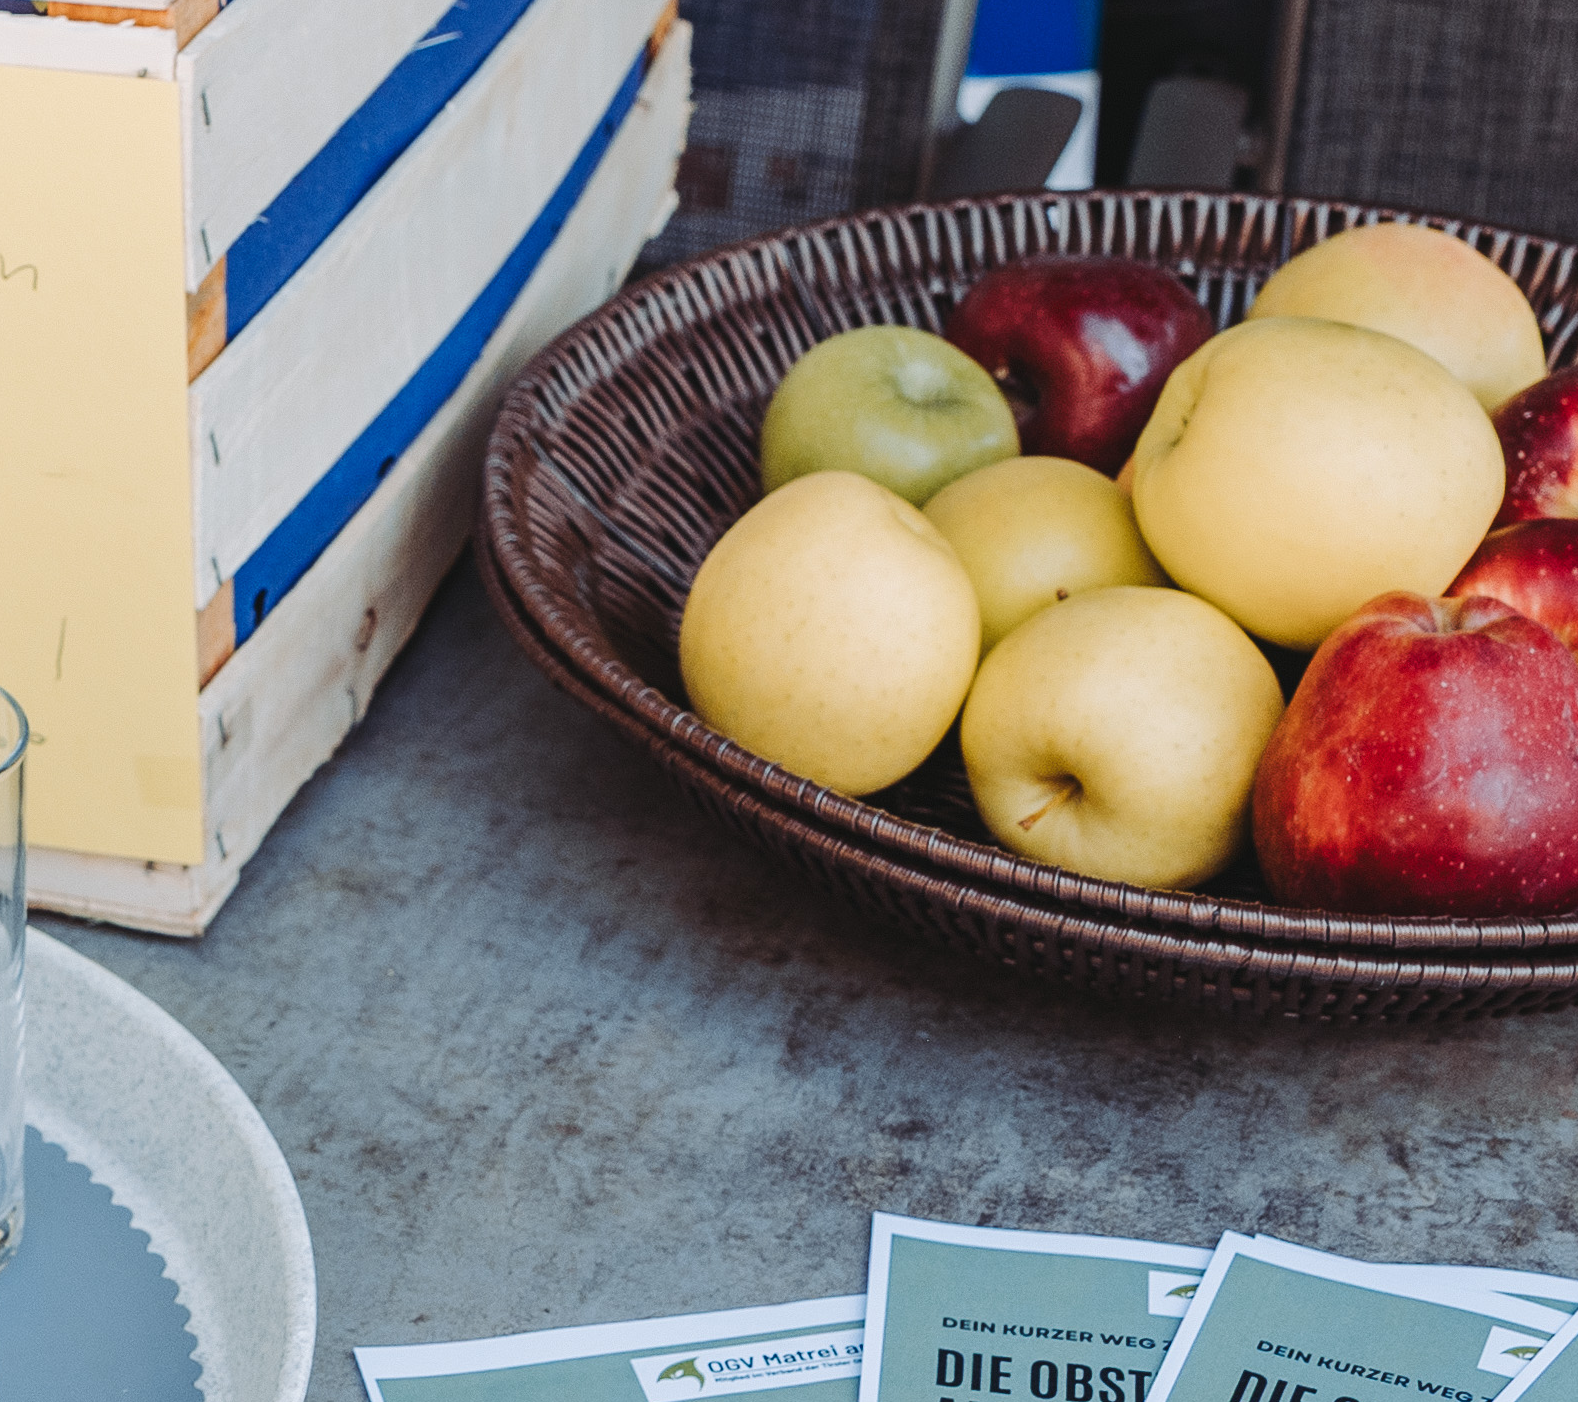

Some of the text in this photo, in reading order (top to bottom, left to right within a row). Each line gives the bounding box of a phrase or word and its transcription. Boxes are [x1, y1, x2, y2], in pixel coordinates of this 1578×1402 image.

[941, 1316, 1157, 1350] DEIN KURZER WEG
[706, 1355, 754, 1374] OGV
[761, 1343, 839, 1367] Matrei
[934, 1347, 1013, 1396] DIE
[1255, 1339, 1313, 1364] DEIN
[1316, 1355, 1411, 1388] KURZER
